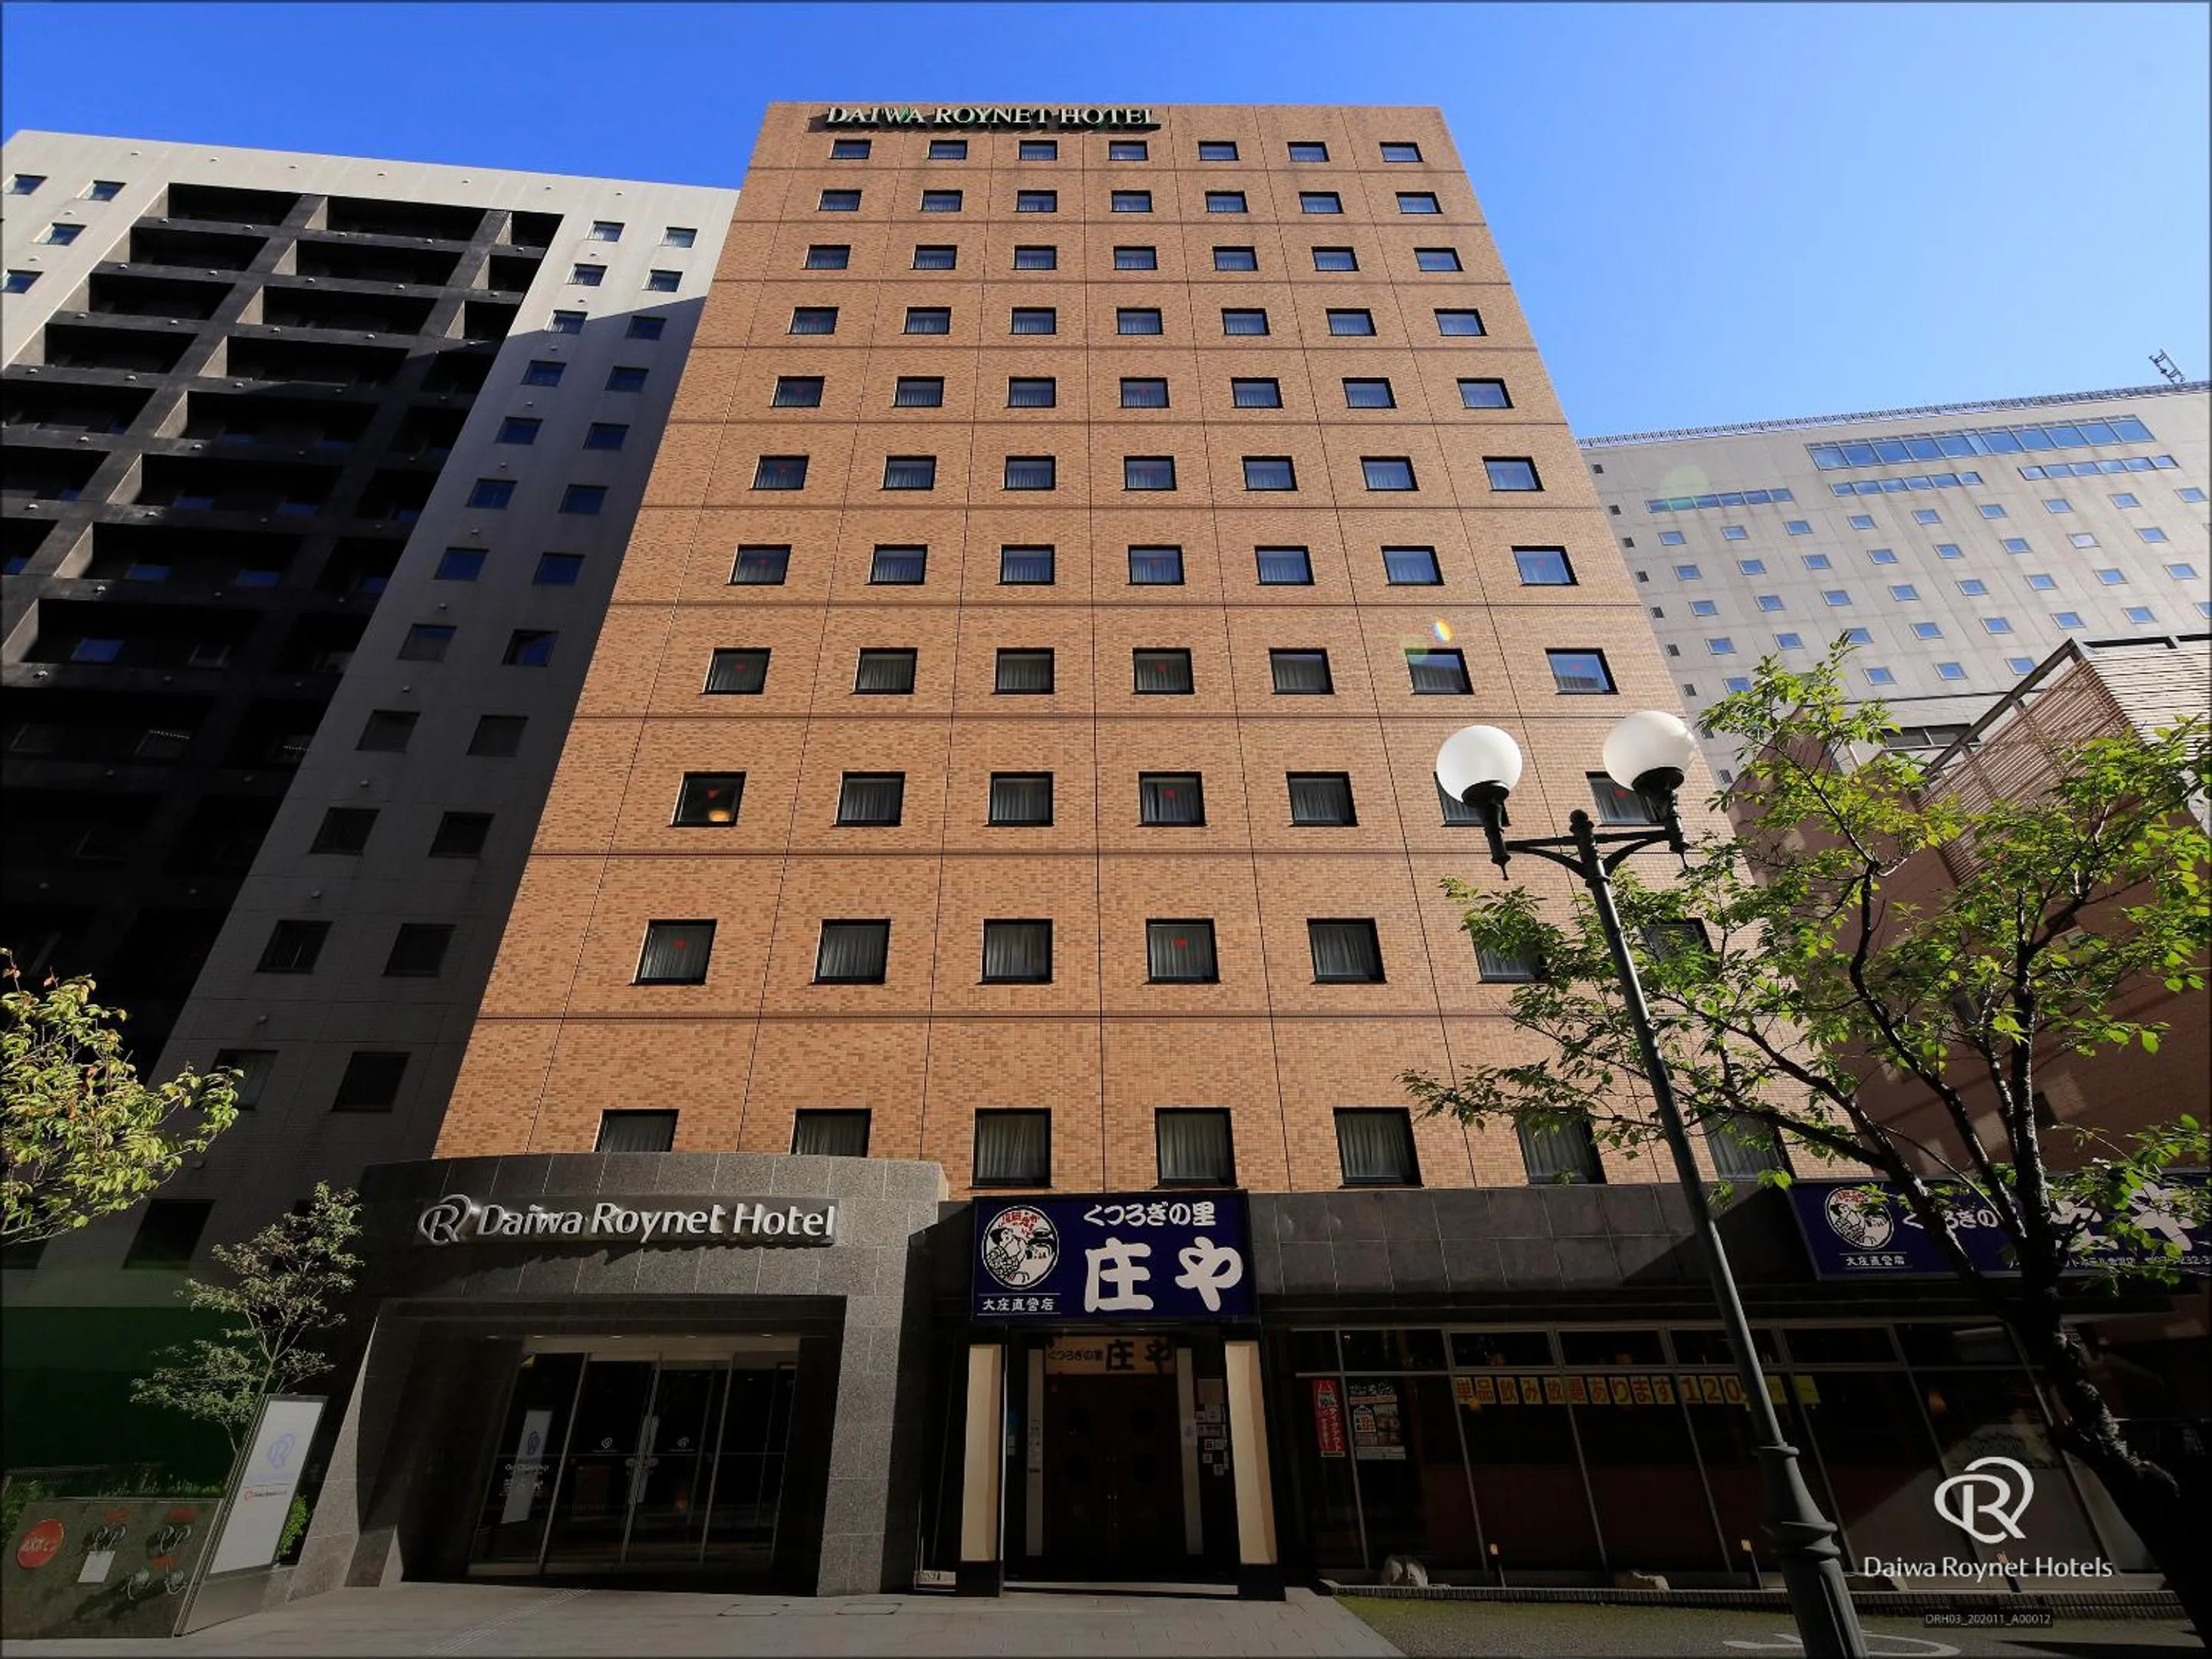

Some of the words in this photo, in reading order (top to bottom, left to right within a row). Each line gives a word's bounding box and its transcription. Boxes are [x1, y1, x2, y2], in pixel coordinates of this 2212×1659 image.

[826, 106, 926, 124] DAIWA
[933, 107, 1052, 124] ROYNET
[1058, 108, 1157, 125] HOTEL
[476, 1203, 583, 1237] Daiwa
[591, 1202, 726, 1243] Roynet
[733, 1202, 836, 1237] Hotel
[1083, 1200, 1217, 1227] くつろぎの里
[1084, 1237, 1243, 1313] 庄や
[982, 1296, 1055, 1312] 大庄直営店
